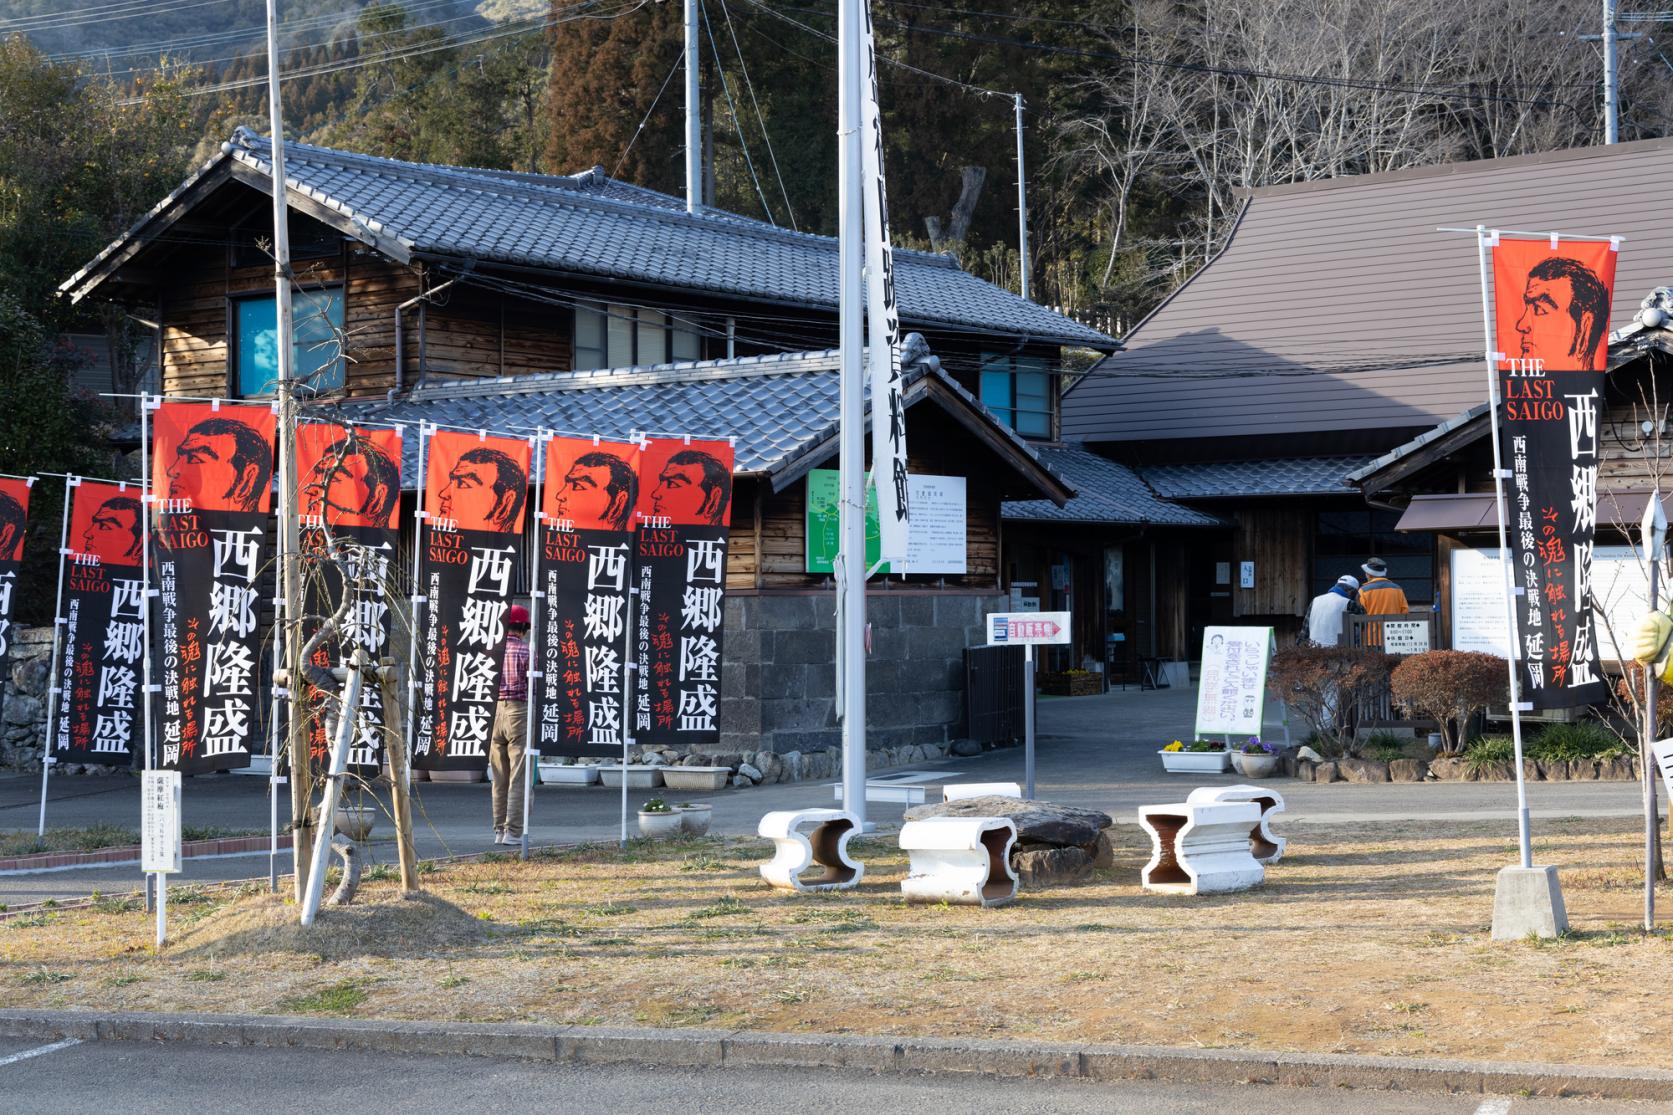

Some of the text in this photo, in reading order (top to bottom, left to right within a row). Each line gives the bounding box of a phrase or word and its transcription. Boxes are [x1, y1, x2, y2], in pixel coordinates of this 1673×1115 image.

[1505, 358, 1546, 377] THE
[1506, 380, 1556, 399] LAST
[1507, 401, 1564, 421] SAIGO
[156, 498, 193, 514] THE
[157, 515, 200, 531] LAST
[430, 516, 459, 533] THE
[547, 518, 575, 533] THE
[641, 515, 672, 529] THE
[158, 532, 209, 549] SAIGO
[430, 532, 465, 549] LAST
[545, 532, 581, 548] LAST
[640, 529, 679, 543] LAST
[1563, 387, 1600, 688] 西郷隆盛
[73, 552, 101, 567] THE
[429, 546, 469, 565] SAIGO
[545, 546, 586, 563] SAIGO
[639, 543, 684, 557] SAIGO
[1512, 435, 1545, 689] 西南戦争最後の決戦地 延岡
[71, 565, 106, 580] LAST
[69, 579, 111, 593] SAIGO
[201, 526, 263, 758] 西郷隆盛
[583, 542, 630, 745] 西郷隆盛
[676, 537, 726, 732] 西郷隆盛
[447, 545, 517, 757] 西郷隆盛
[541, 569, 560, 743] 西南戦争最後の決戦地 延岡
[636, 565, 653, 731] 西南戦争最後の決戦地 延岡
[91, 578, 151, 754] 西郷隆盛
[161, 561, 181, 767] 西南戦争最後の決戦地 延岡
[57, 716, 71, 751] 延岡
[415, 715, 433, 757] 延岡
